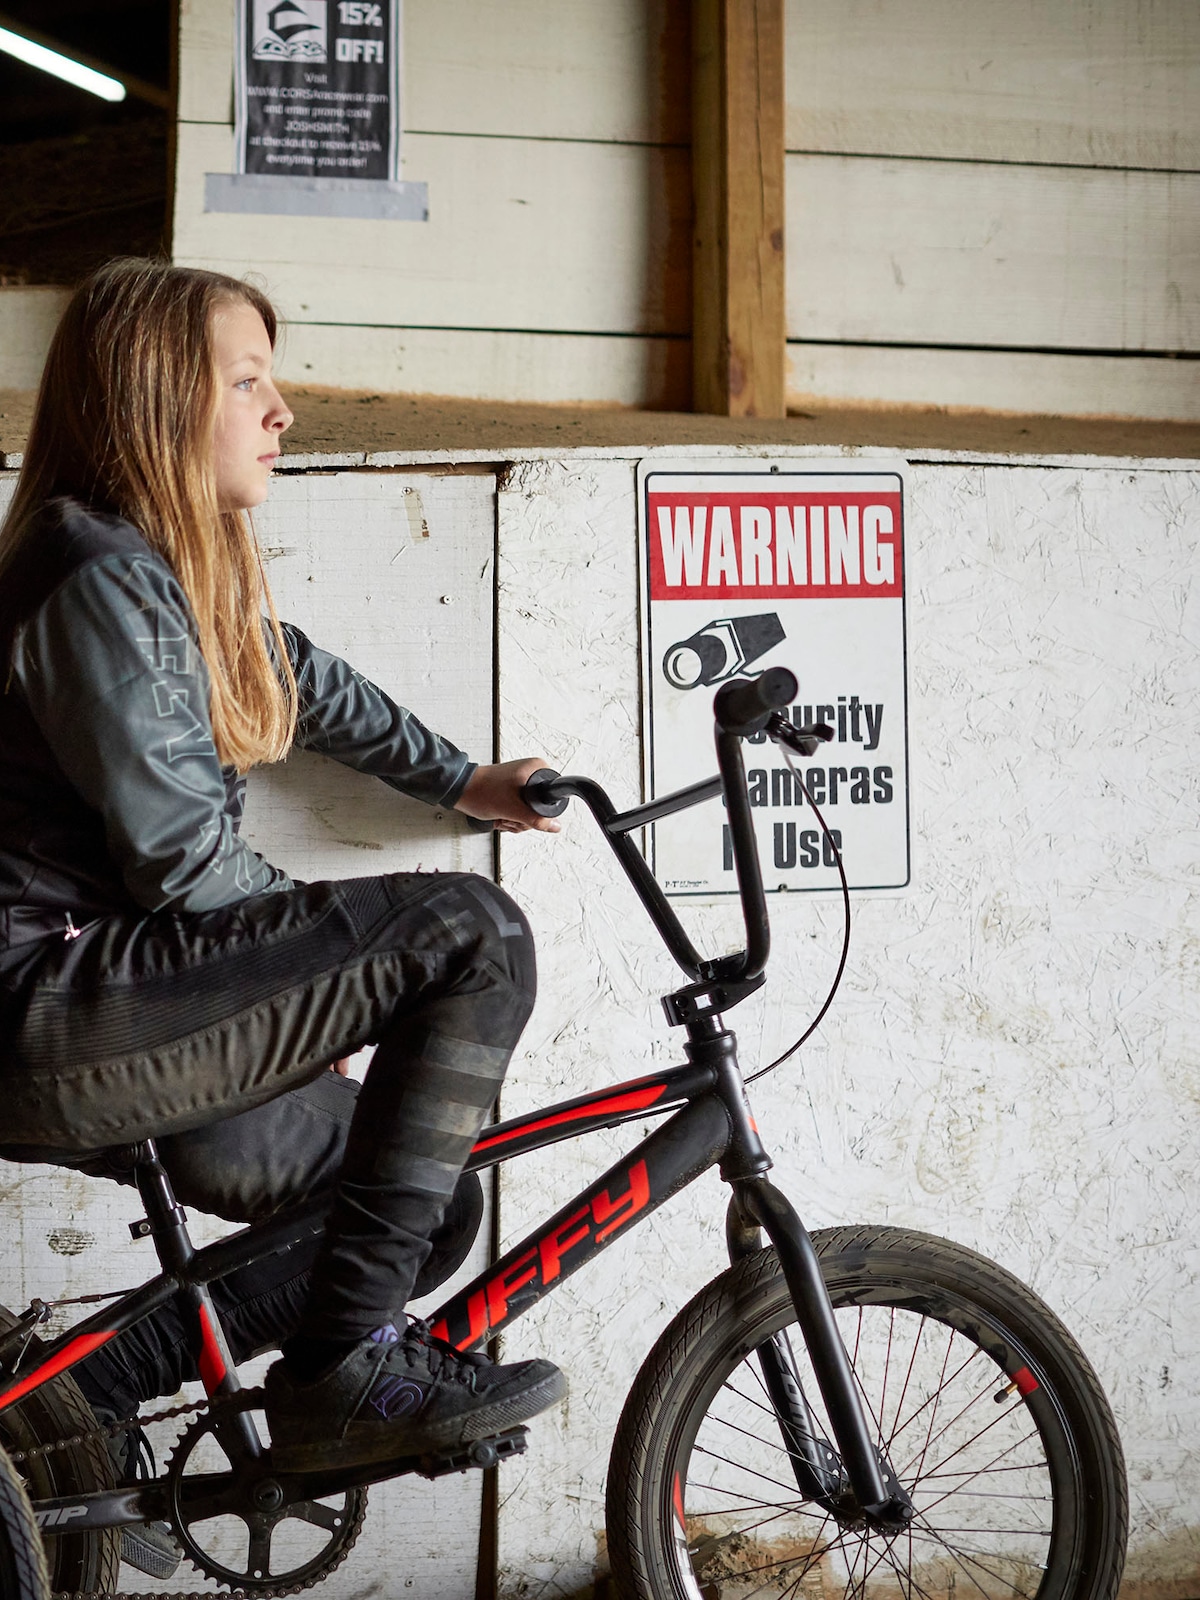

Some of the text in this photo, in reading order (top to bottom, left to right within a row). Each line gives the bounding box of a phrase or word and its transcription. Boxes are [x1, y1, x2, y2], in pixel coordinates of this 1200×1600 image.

[337, 1, 383, 26] 15%
[335, 38, 384, 64] OFF!
[656, 505, 895, 587] WARNING
[745, 696, 884, 750] urity
[725, 766, 893, 808] ameras
[773, 822, 843, 869] Use
[430, 1158, 650, 1352] UFFY
